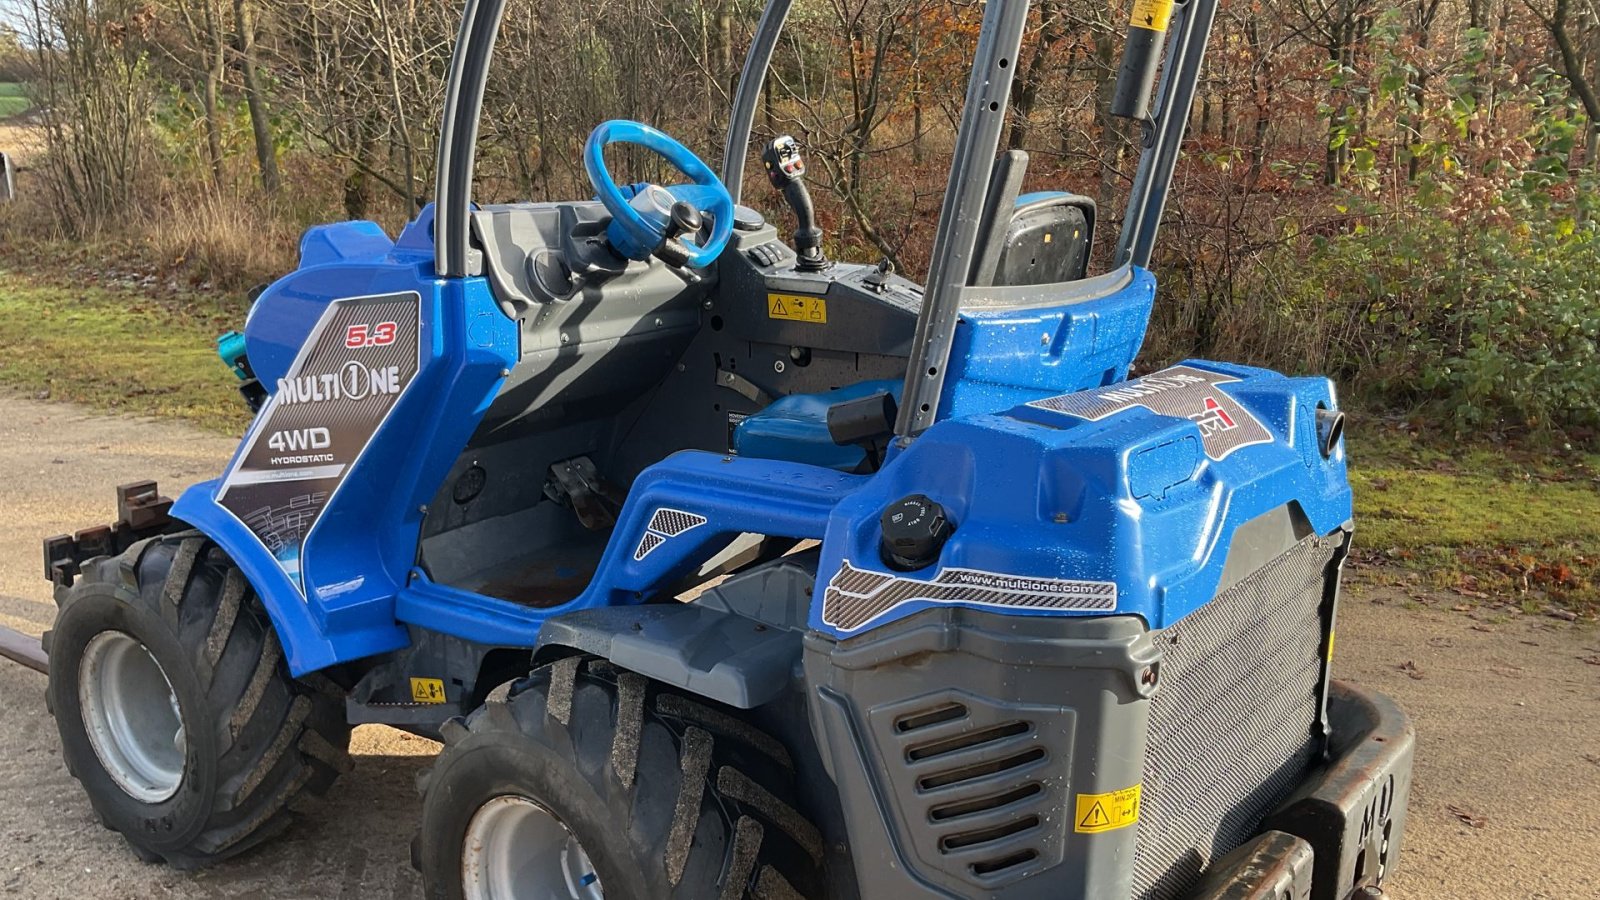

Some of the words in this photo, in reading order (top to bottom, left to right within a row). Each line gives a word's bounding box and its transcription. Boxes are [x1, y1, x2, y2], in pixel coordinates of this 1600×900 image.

[345, 321, 397, 348] 5.3
[268, 427, 331, 452] 4WD
[270, 453, 334, 465] HYDROSTATIC
[959, 573, 1094, 593] www.multione.com
